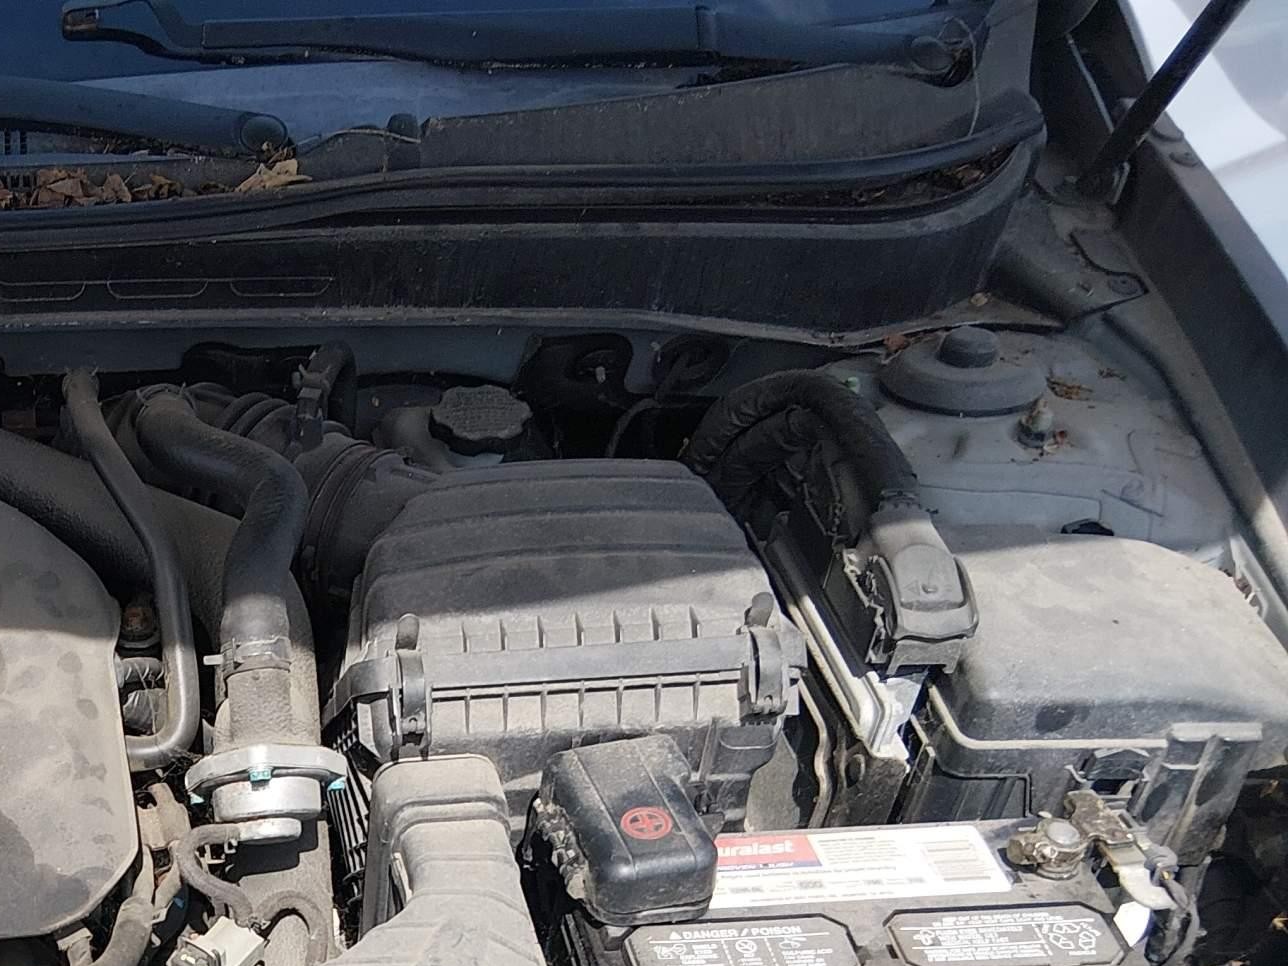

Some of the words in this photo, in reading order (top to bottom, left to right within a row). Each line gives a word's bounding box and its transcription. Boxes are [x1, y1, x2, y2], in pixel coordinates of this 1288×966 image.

[718, 839, 793, 857] uralast
[682, 930, 738, 940] DANGER
[751, 926, 803, 936] POISON
